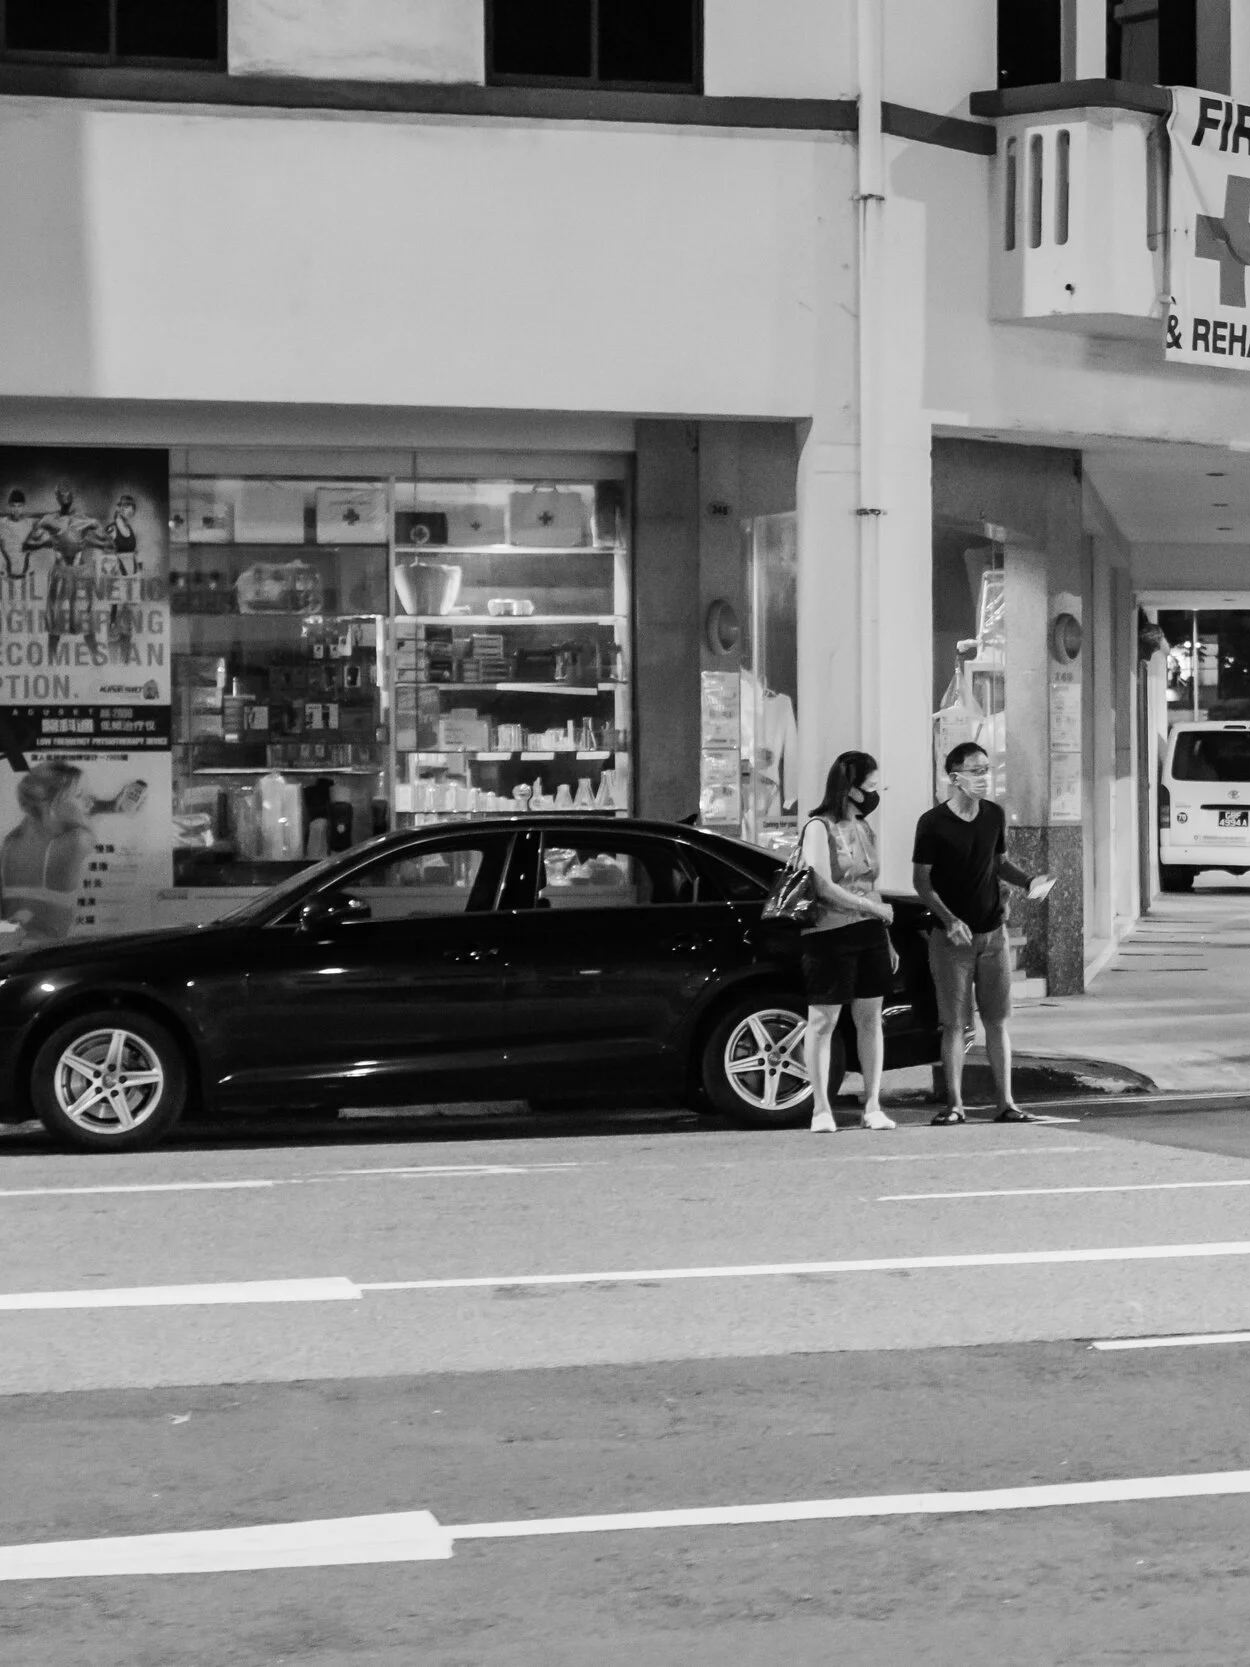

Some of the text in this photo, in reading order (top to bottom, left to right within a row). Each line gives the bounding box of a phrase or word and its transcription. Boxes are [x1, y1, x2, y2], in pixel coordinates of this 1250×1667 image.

[1166, 314, 1182, 350] &
[0, 577, 43, 601] TIL
[0, 641, 164, 667] COMES AN
